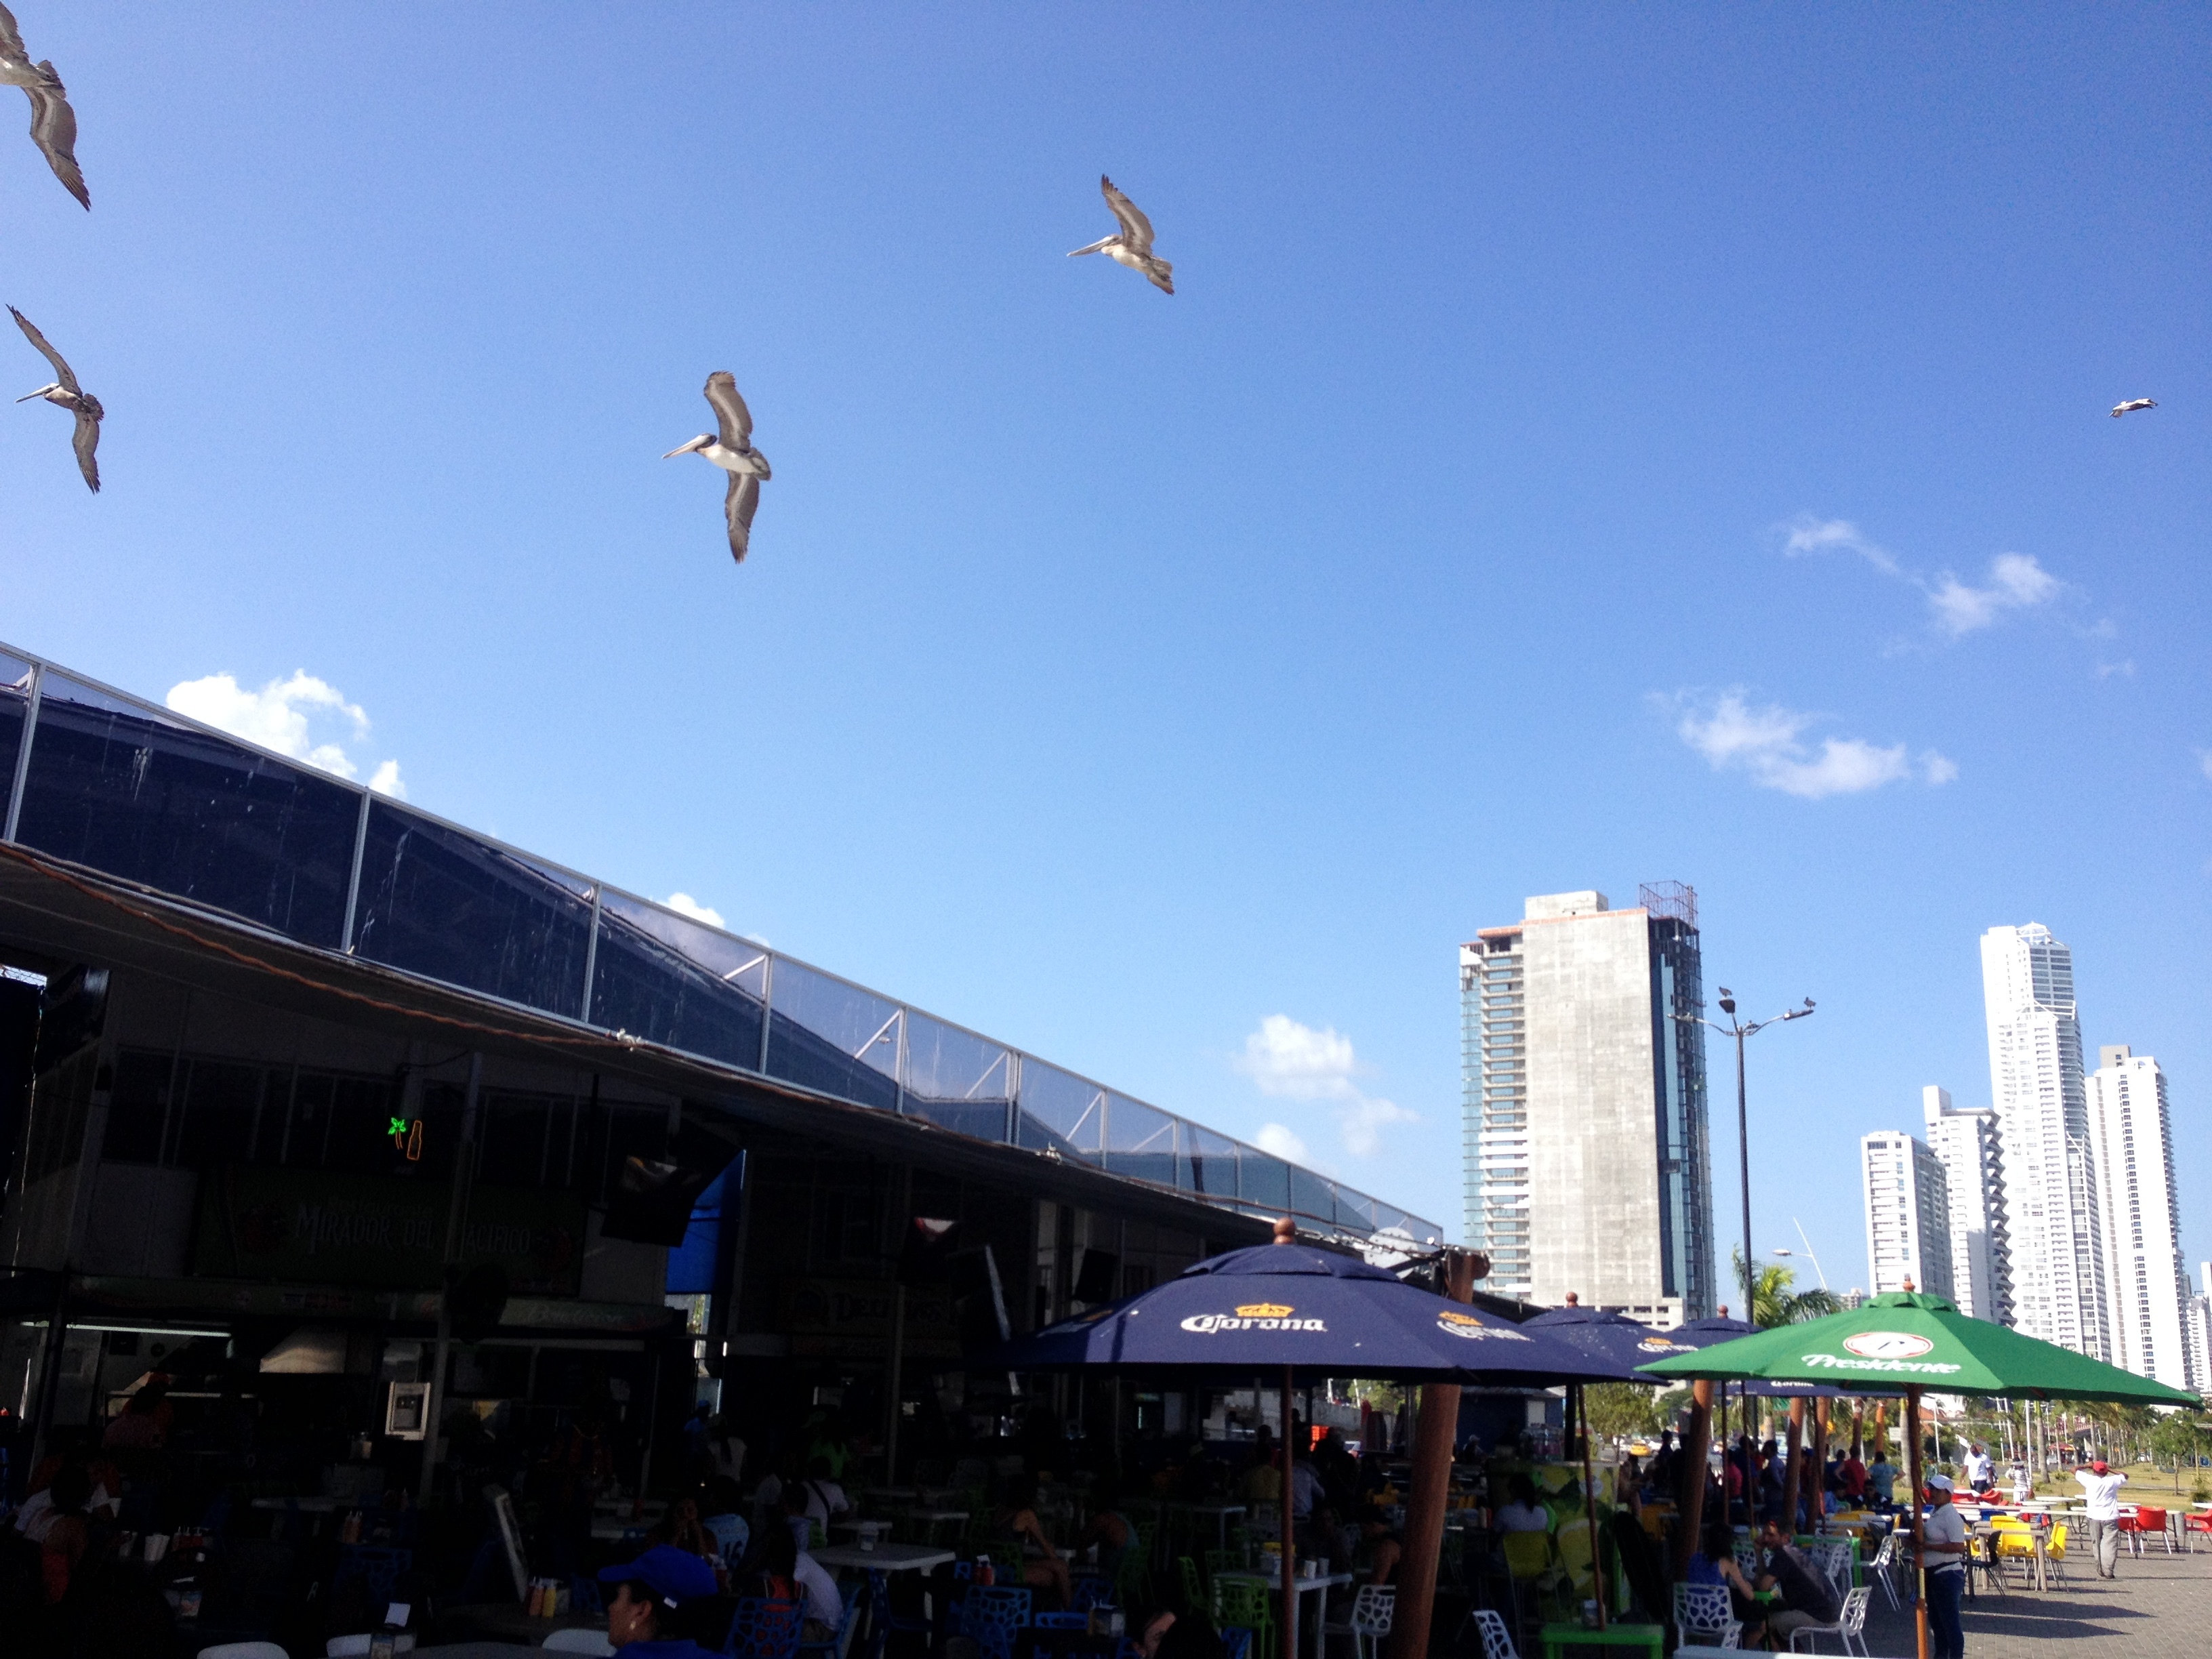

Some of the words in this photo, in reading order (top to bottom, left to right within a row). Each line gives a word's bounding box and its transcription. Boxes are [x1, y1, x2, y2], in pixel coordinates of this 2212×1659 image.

[293, 1204, 393, 1255] MIRADOR
[405, 1218, 434, 1249] DEL
[450, 1223, 531, 1254] ACIFICO
[1181, 1314, 1328, 1334] Corona
[1801, 1354, 1962, 1374] Presidente
